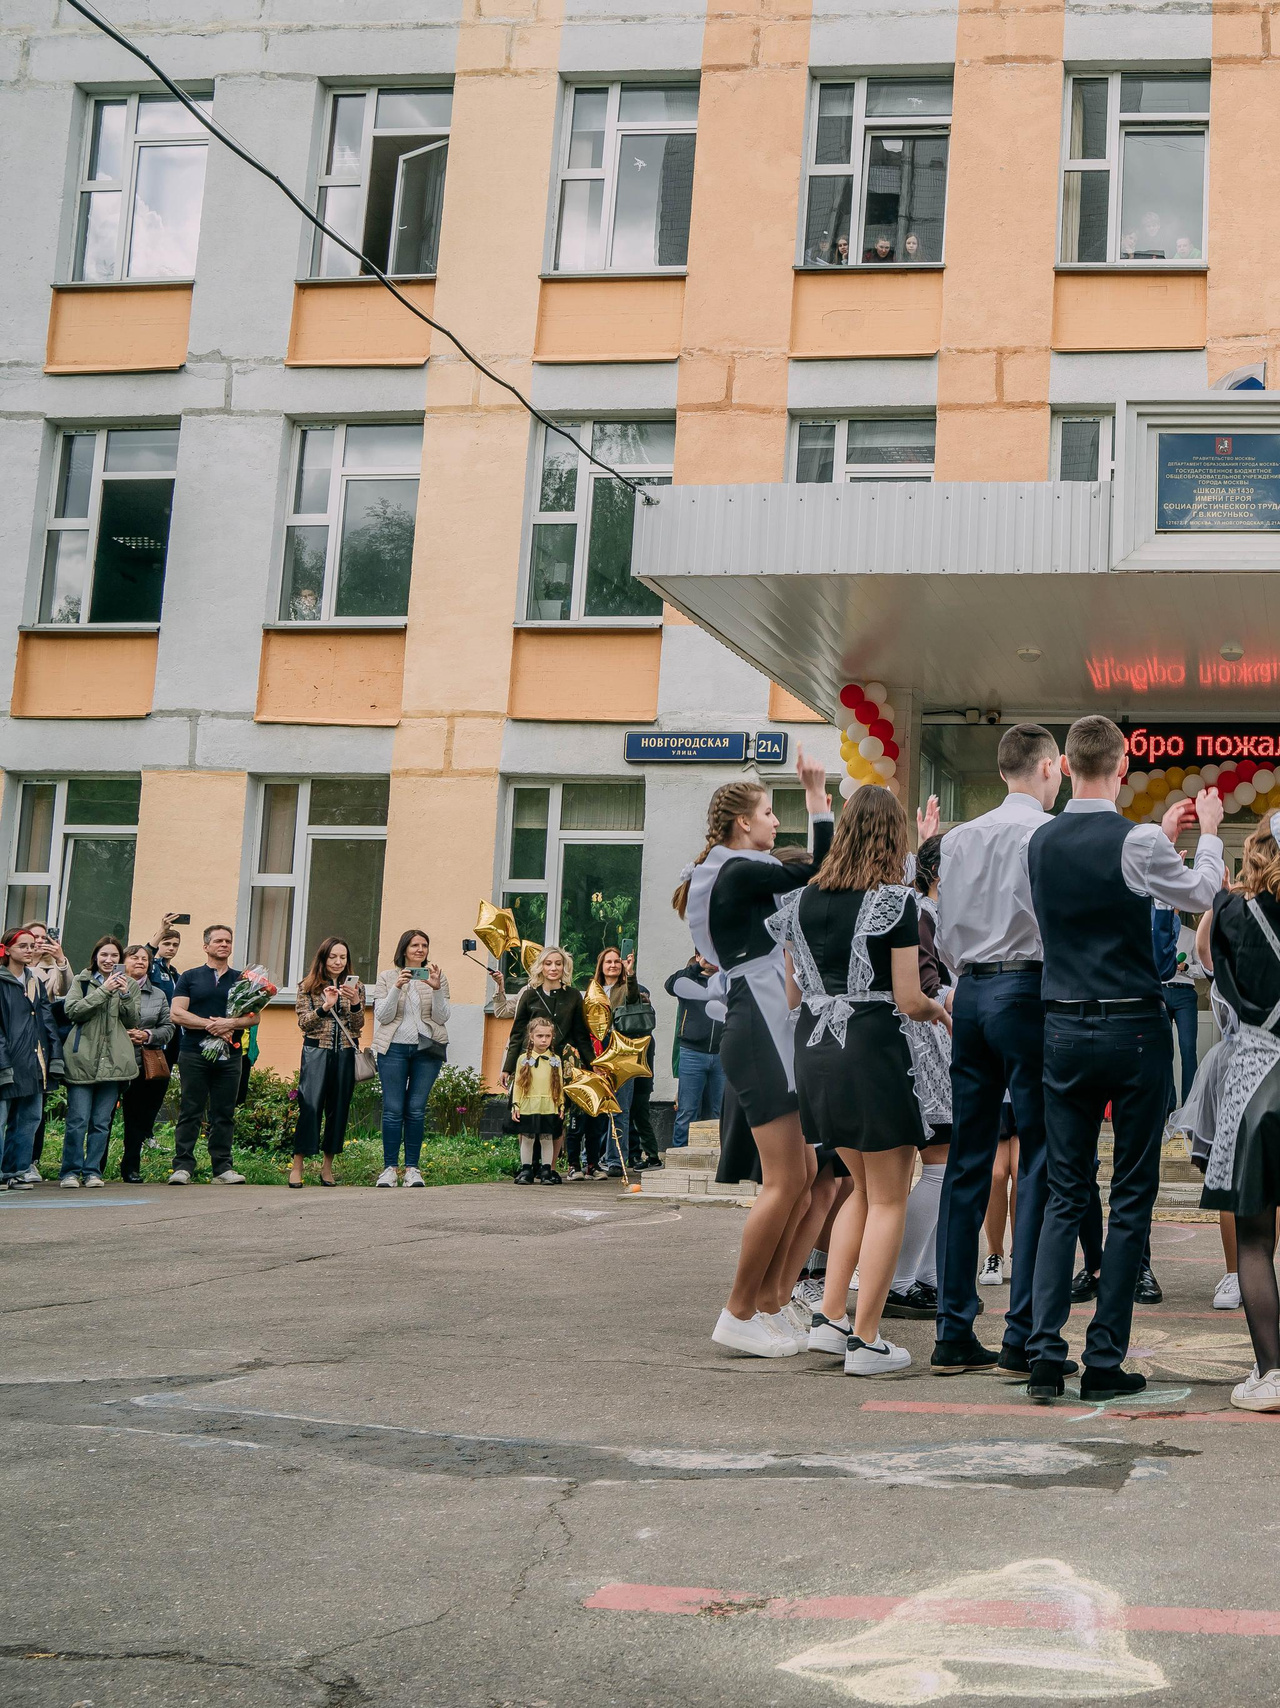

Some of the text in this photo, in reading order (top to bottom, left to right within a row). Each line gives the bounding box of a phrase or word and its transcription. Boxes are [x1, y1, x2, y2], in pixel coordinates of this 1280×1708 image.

[641, 737, 730, 749] НОВГОРОДСКАЯ
[757, 740, 780, 753] 21А
[1124, 728, 1184, 763] бро
